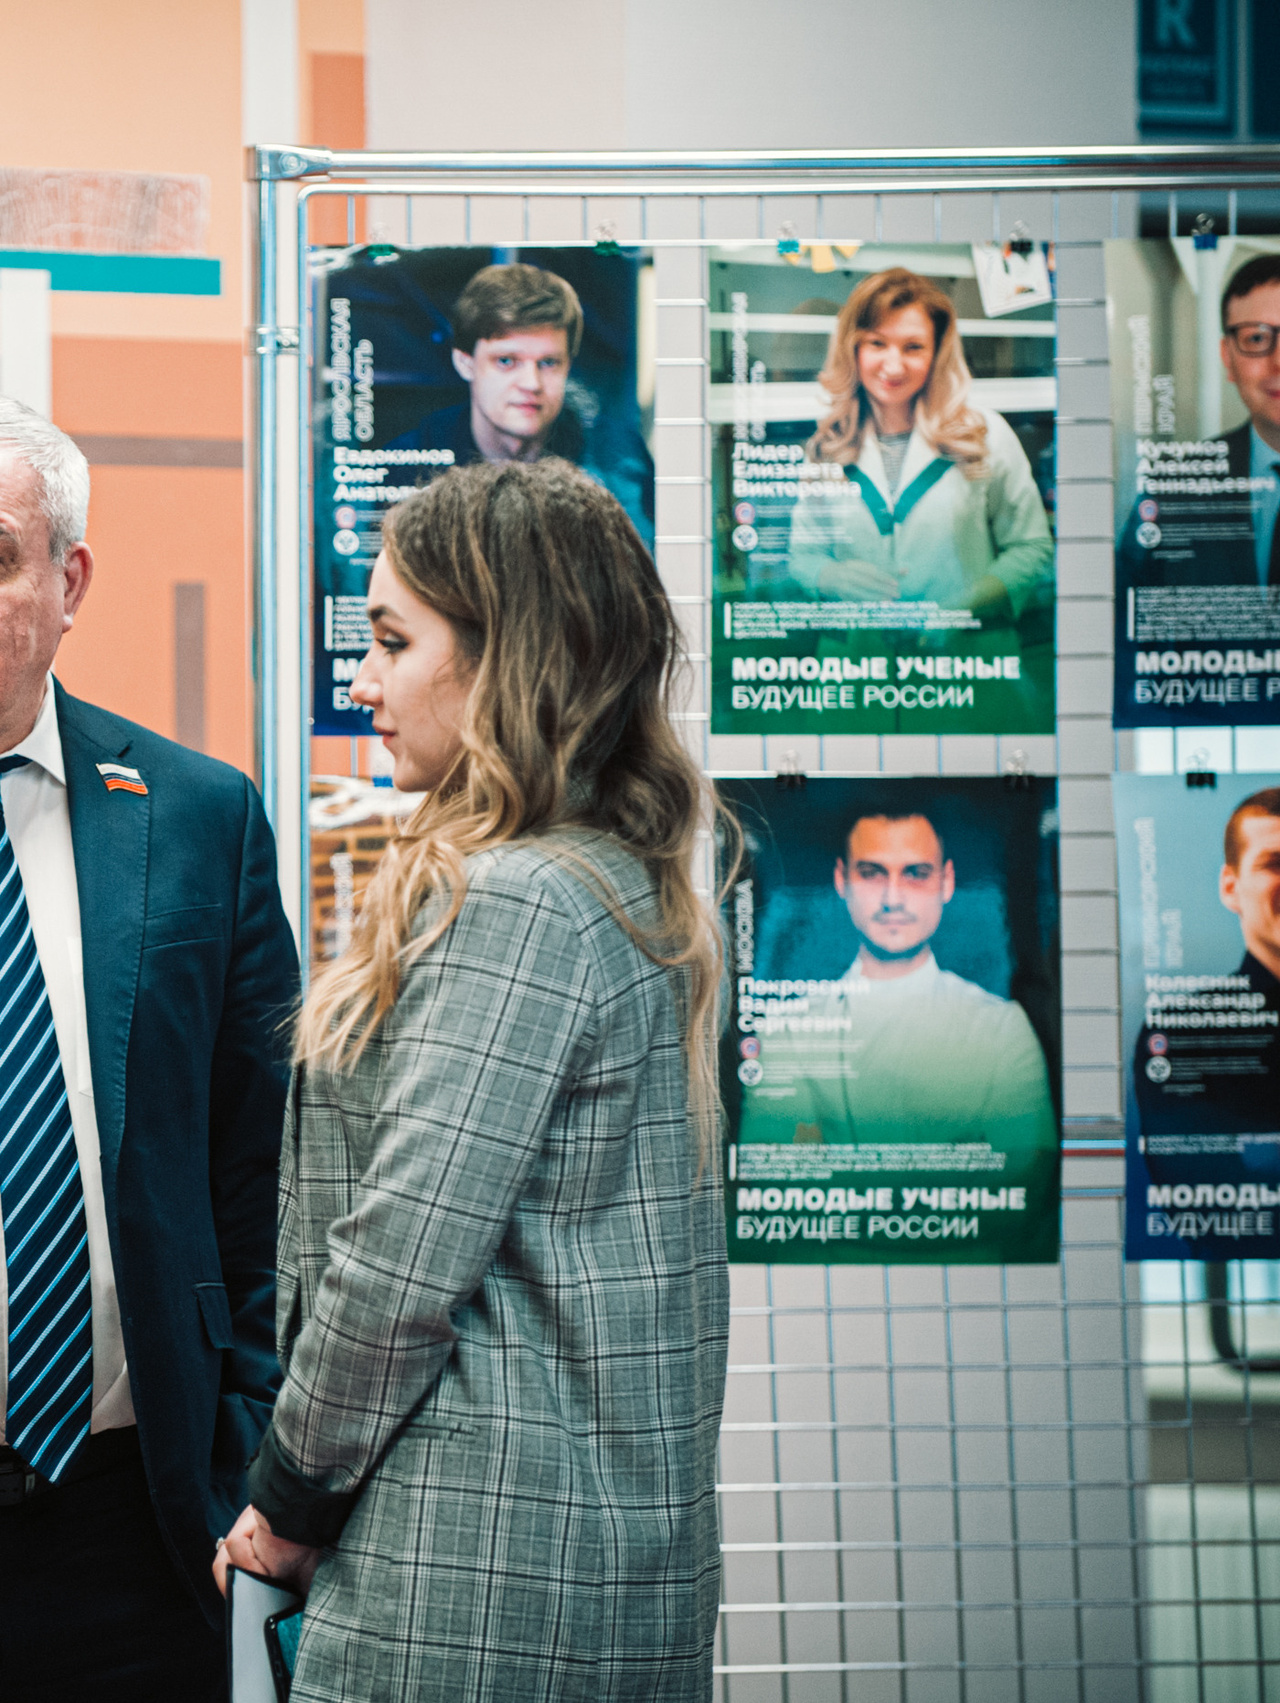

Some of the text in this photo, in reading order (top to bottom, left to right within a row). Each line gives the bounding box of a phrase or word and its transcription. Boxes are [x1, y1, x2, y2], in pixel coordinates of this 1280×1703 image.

[354, 339, 374, 441] ОБЛАСТЬ
[333, 465, 389, 484] Олег
[732, 656, 1020, 683] МОЛОДЫЕ УЧЕНЫЕ
[1136, 650, 1280, 677] МОЛОДЫ
[732, 686, 974, 713] БУДУЩЕЕ РОССИИ
[1136, 678, 1259, 706] БУДУЩЕЕ
[737, 1188, 1027, 1214] МОЛОДЫЕ УЧЕНЫЕ
[736, 1216, 979, 1243] БУДУЩЕЕ РОССИИ
[1147, 1211, 1273, 1240] БУДУЩЕЕ
